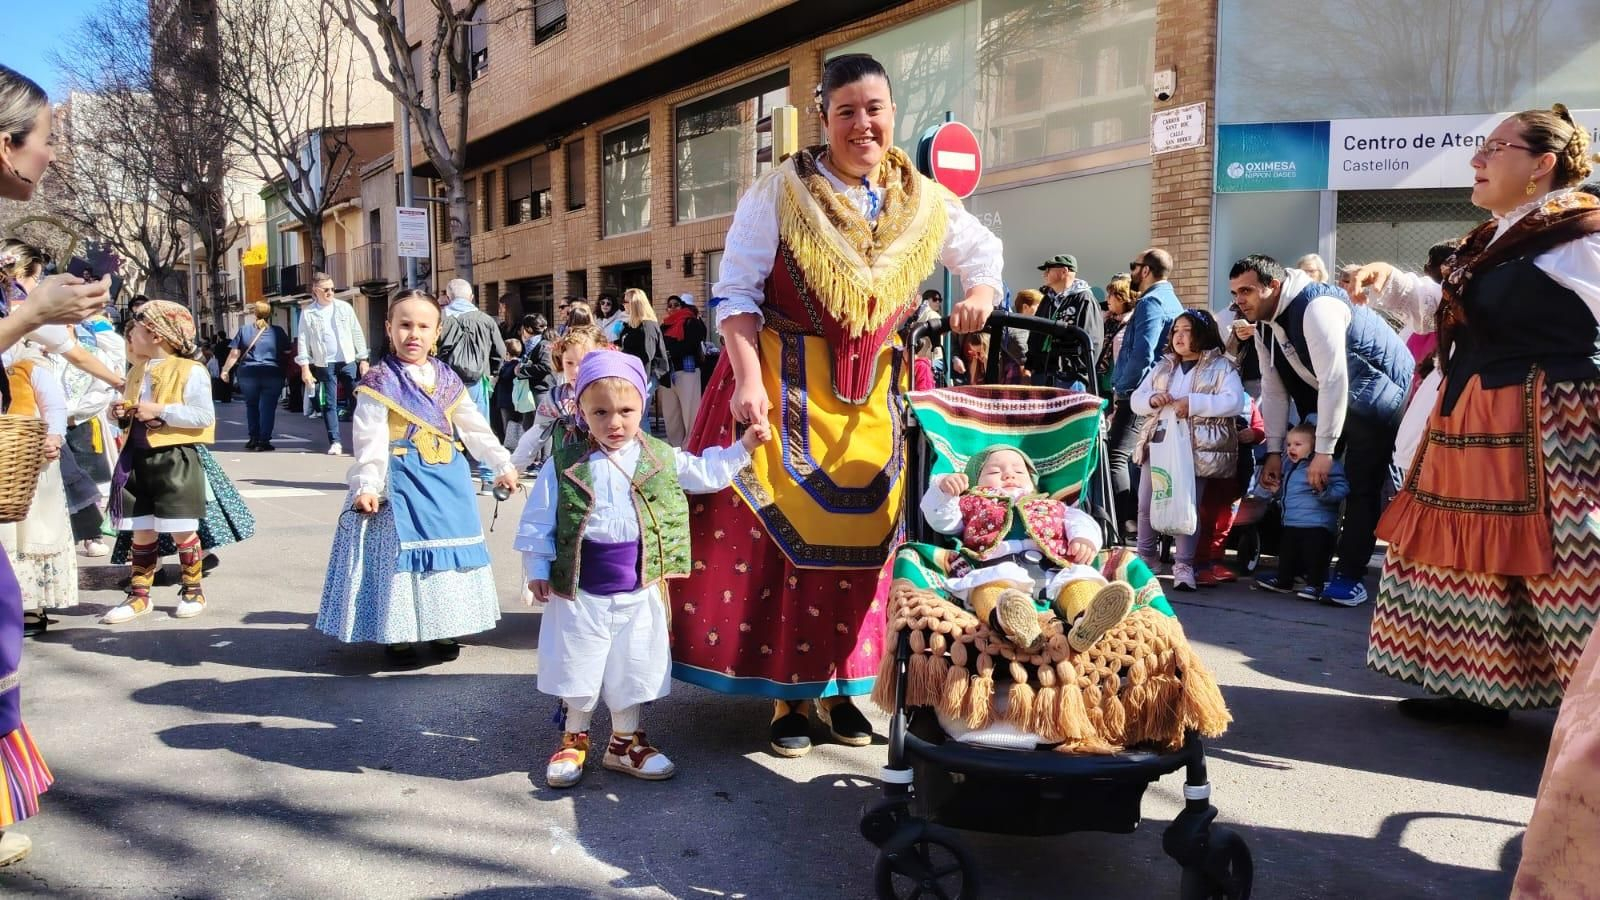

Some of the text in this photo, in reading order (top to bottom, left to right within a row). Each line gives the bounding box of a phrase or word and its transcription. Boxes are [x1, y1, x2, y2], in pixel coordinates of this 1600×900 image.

[1344, 135, 1407, 150] Centro
[1412, 133, 1436, 148] de
[1245, 161, 1296, 171] OXIMESA
[1343, 158, 1409, 171] Castellón
